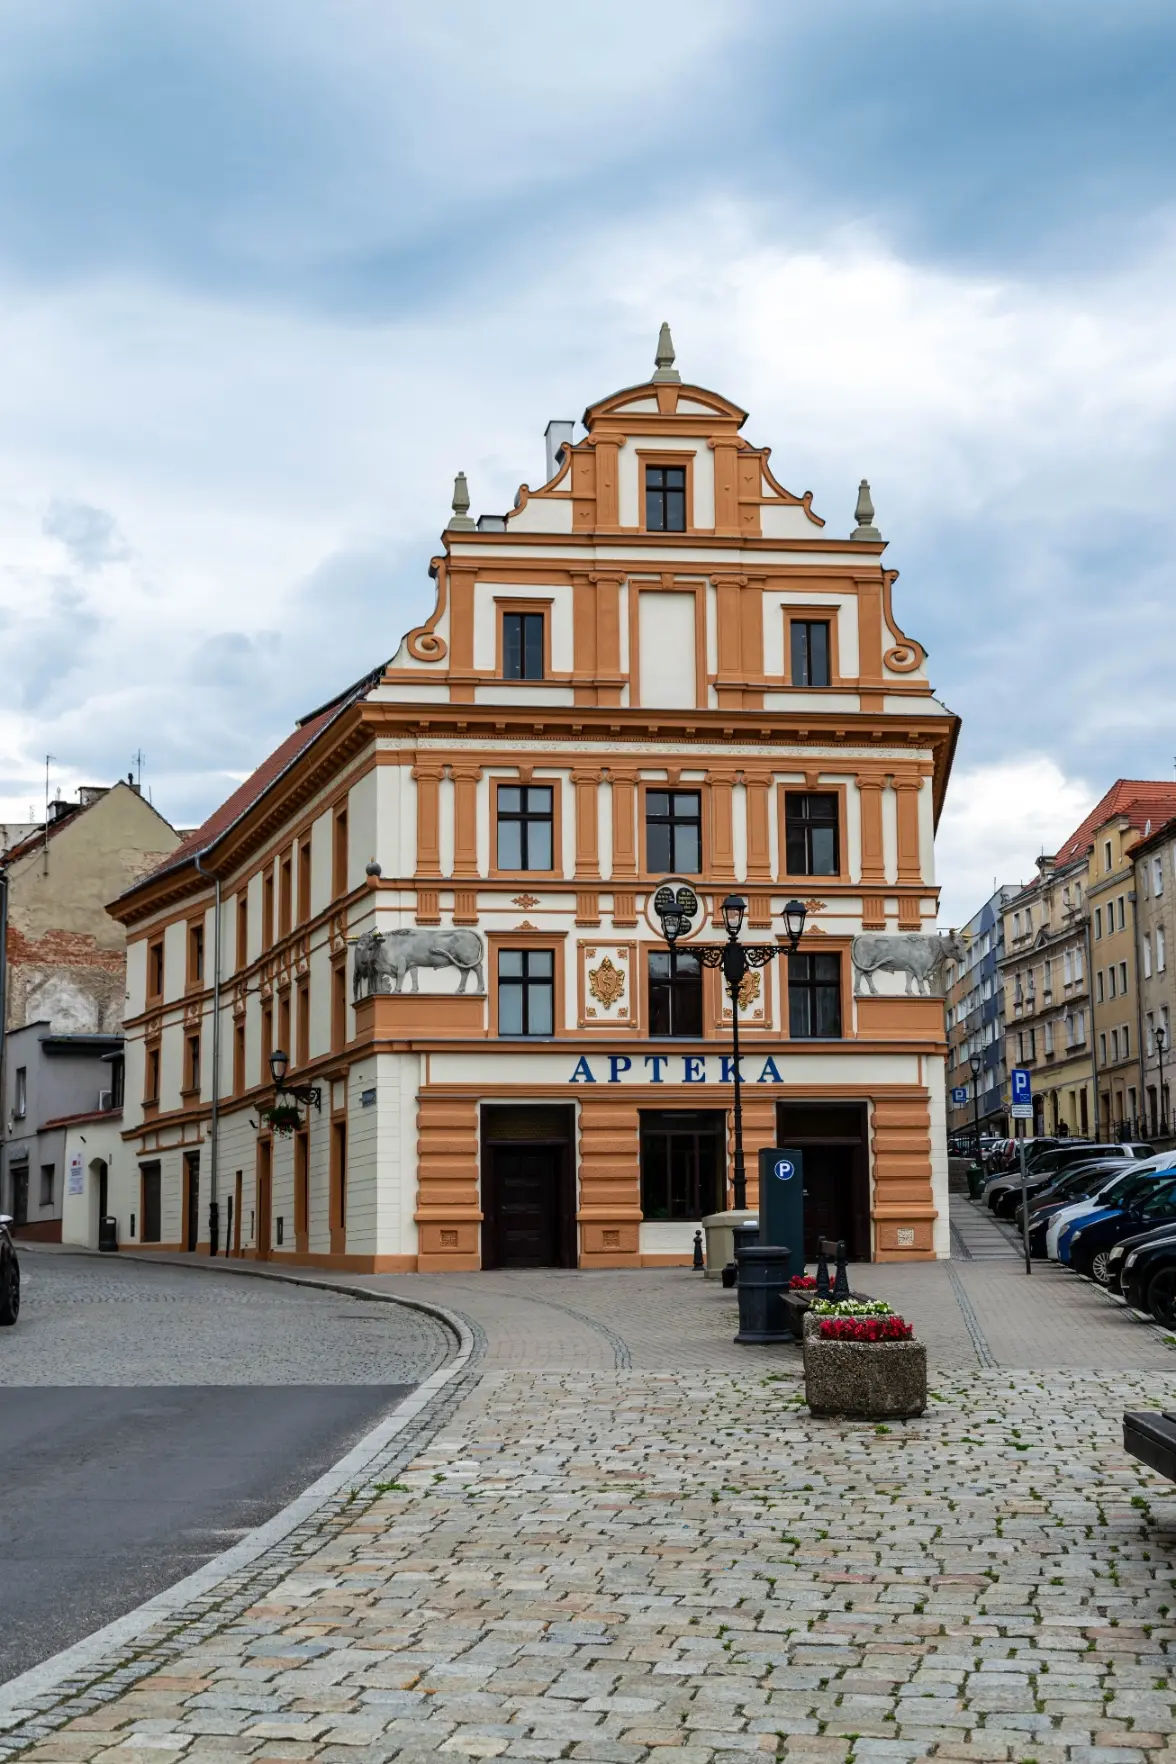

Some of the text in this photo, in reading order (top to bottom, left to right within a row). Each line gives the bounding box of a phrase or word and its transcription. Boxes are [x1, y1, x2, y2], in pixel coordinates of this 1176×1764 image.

[568, 1055, 784, 1083] APTEKA
[1016, 1072, 1027, 1094] P
[955, 1090, 964, 1101] P
[779, 1162, 791, 1177] P
